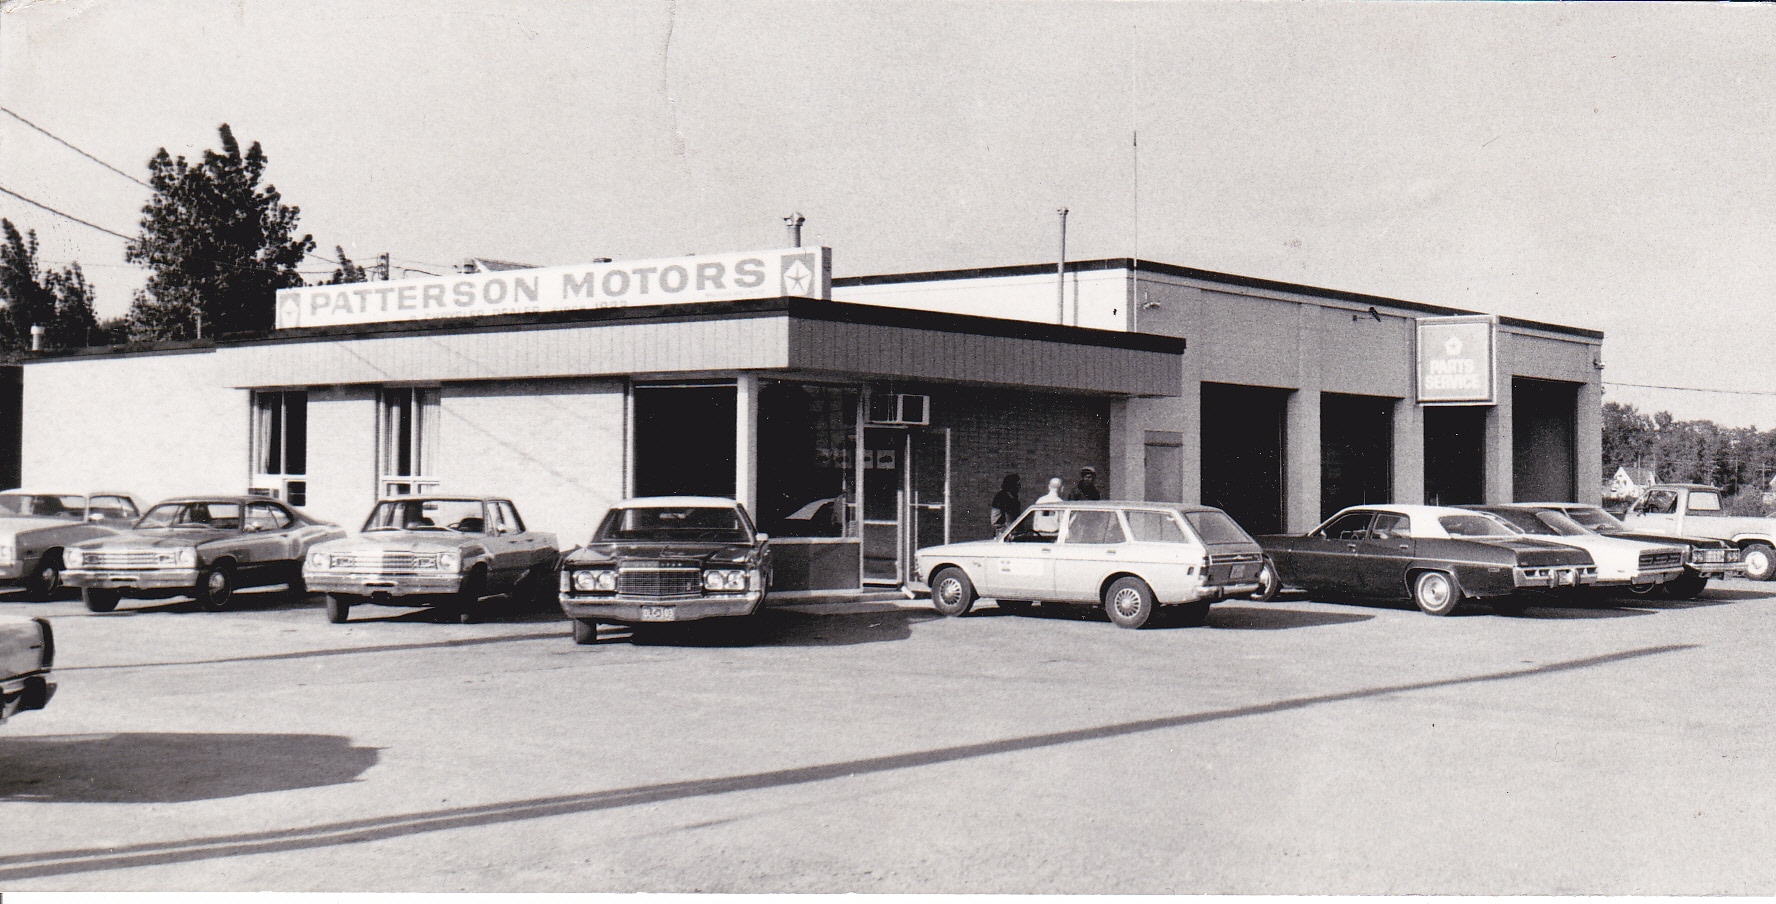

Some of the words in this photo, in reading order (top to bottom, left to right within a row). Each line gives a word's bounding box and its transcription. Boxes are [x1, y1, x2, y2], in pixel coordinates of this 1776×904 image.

[310, 277, 538, 315] PATTERSON
[563, 258, 766, 299] MOTORS
[1430, 358, 1474, 373] PARTS
[1424, 374, 1480, 390] SERVICE
